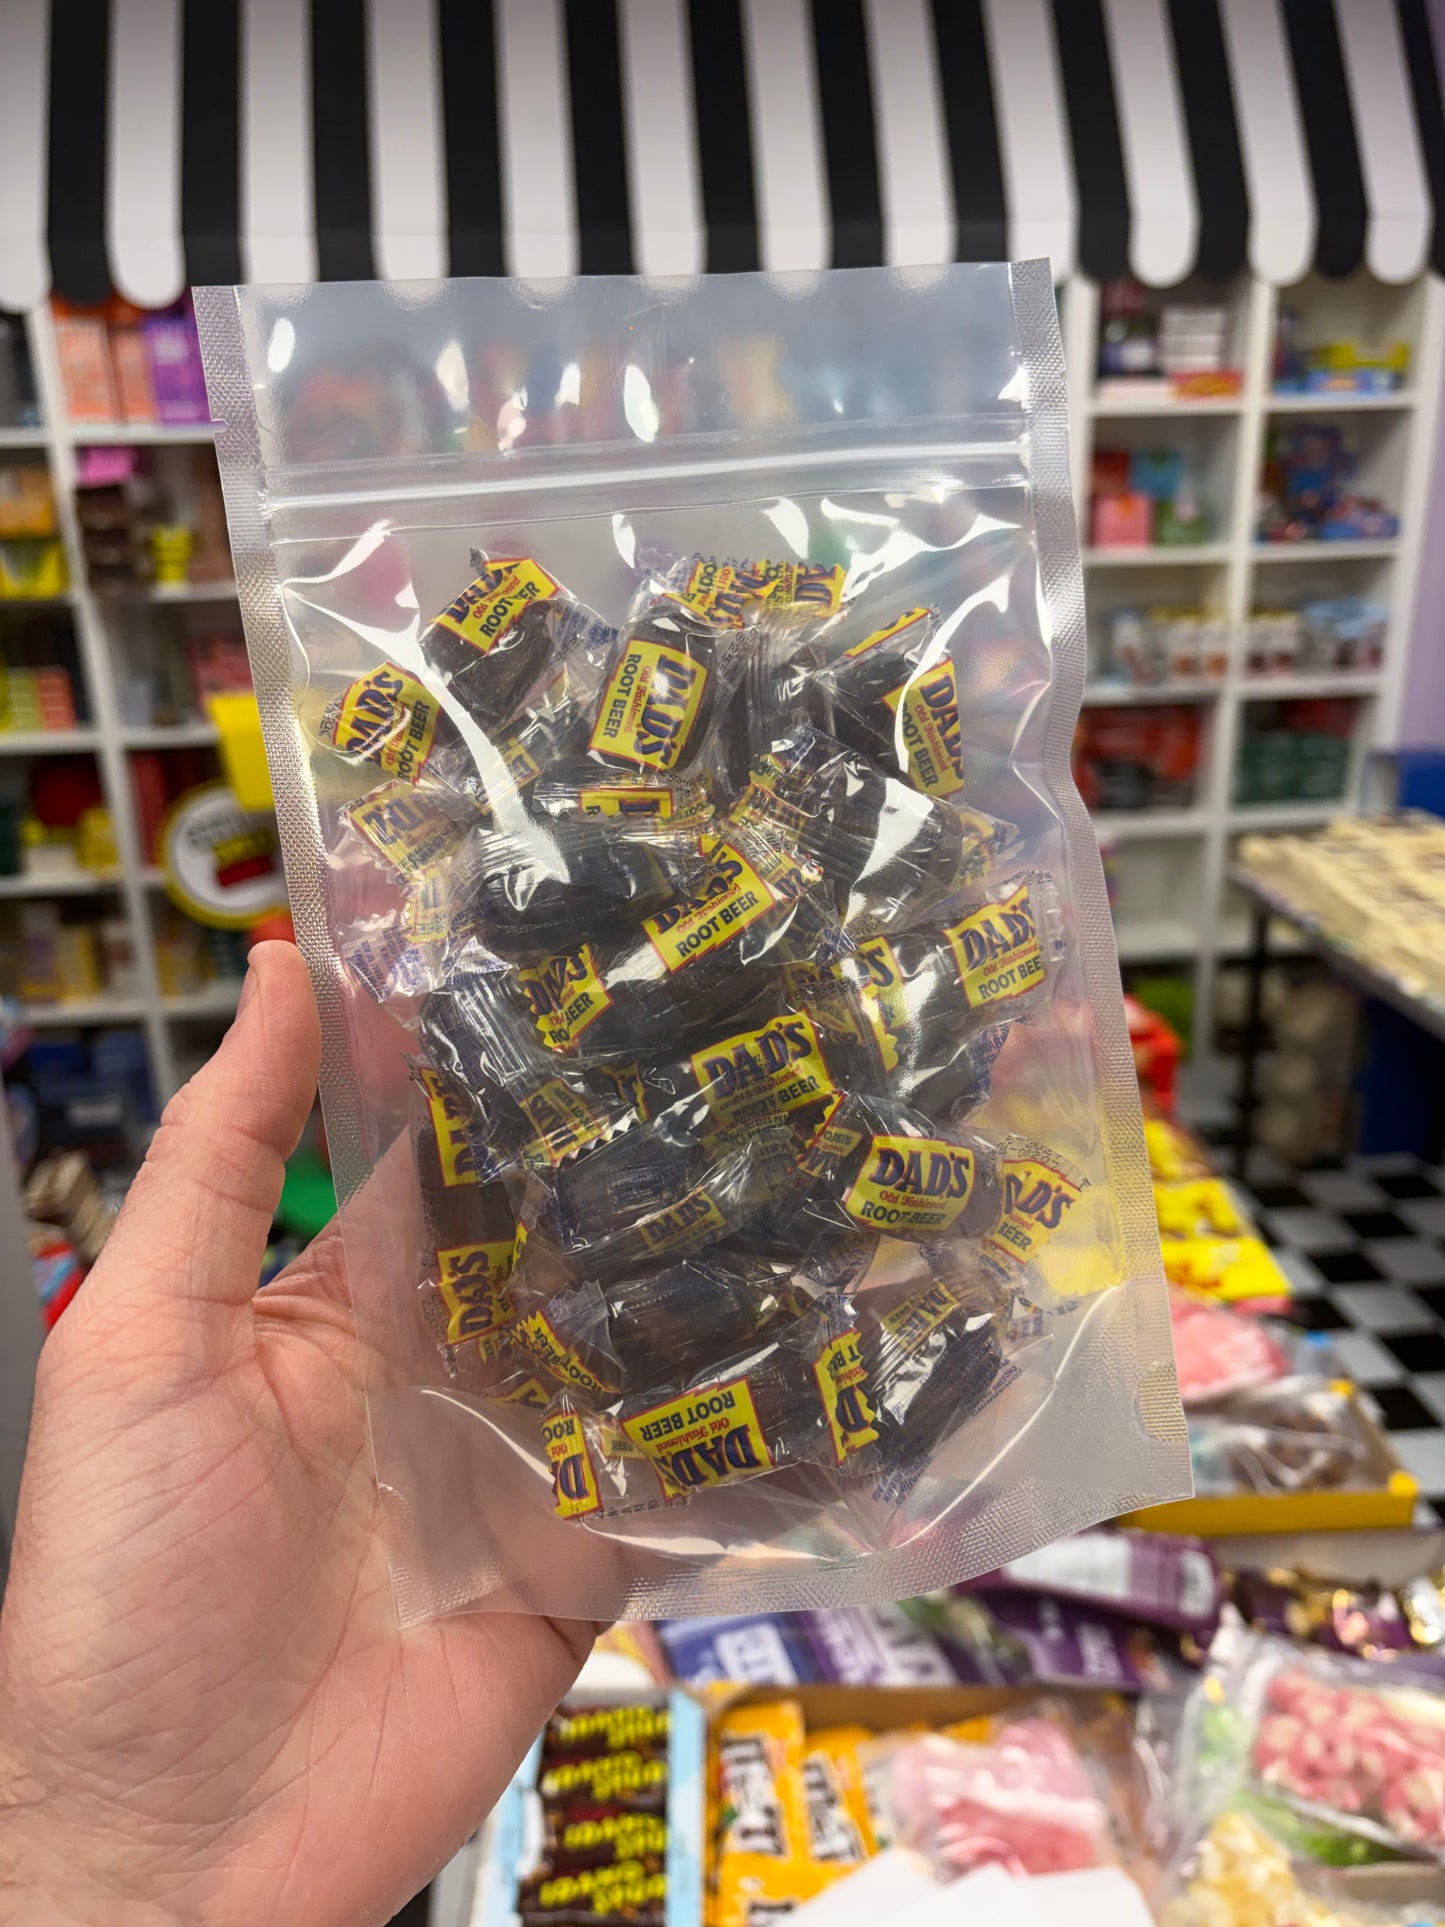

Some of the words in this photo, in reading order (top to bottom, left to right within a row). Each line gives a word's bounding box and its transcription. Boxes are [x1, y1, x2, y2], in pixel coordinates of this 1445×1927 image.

[616, 653, 642, 697] ROOT
[409, 700, 432, 741] BEER
[602, 698, 629, 739] BEER
[633, 654, 698, 767] DAD'S
[914, 748, 940, 788] BEER
[674, 915, 722, 958] ROOT
[718, 890, 760, 926] BEER
[978, 968, 1017, 1000] ROOT
[1016, 954, 1042, 980] BEE
[702, 1021, 812, 1099] DAD'S
[777, 1075, 821, 1104] BEER
[868, 1147, 970, 1199] DAD'S
[860, 1200, 908, 1225] ROOT
[906, 1211, 947, 1225] BEER
[880, 1189, 899, 1205] Old
[638, 1411, 686, 1442] BEER
[686, 1391, 737, 1425] ROOT
[708, 1417, 731, 1432] Old
